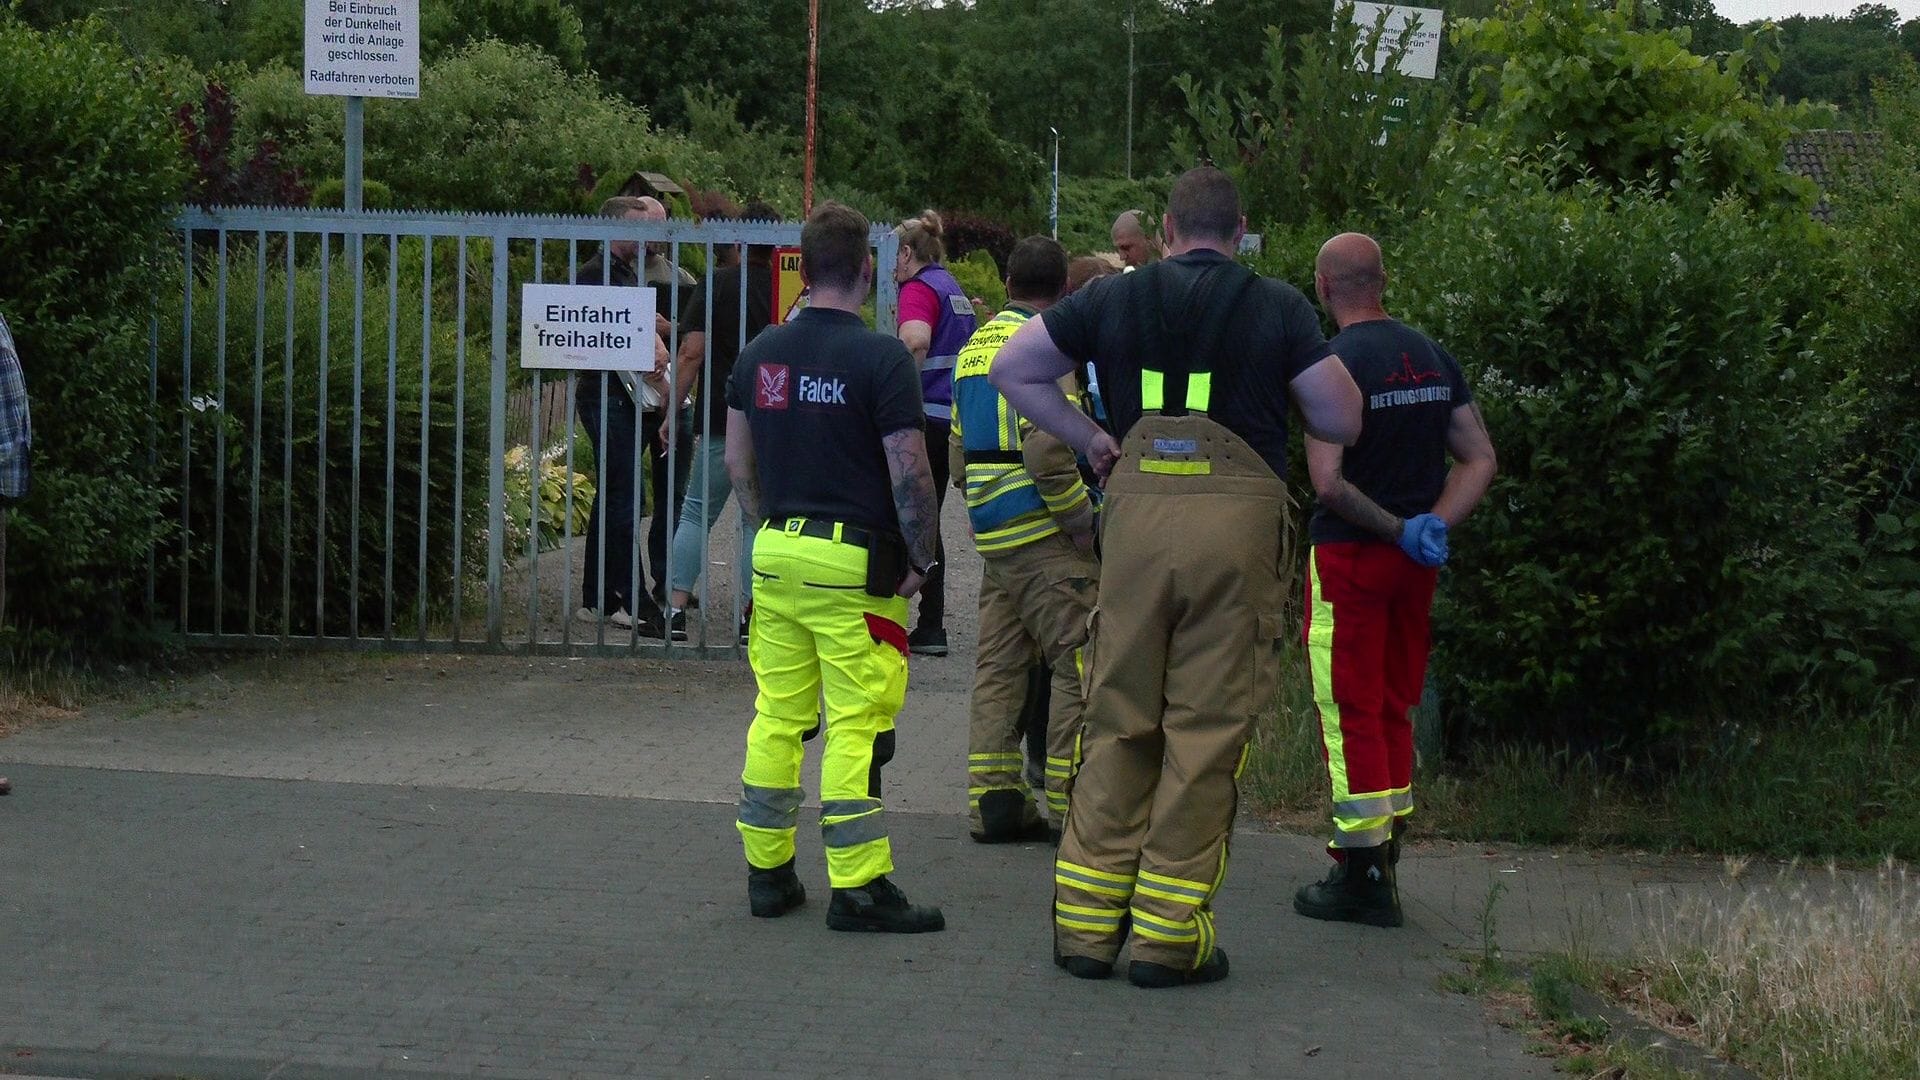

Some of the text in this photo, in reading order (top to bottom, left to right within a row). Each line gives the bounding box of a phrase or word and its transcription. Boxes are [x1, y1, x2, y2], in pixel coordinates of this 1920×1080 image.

[329, 1, 397, 16] Bei Einbruch
[325, 16, 401, 32] der Dunkelheit
[322, 32, 404, 49] wird die Anlage
[328, 49, 398, 62] geschlossen.
[310, 70, 414, 85] Radfahren verboten
[546, 305, 631, 324] Einfahrt
[798, 375, 846, 405] Falck
